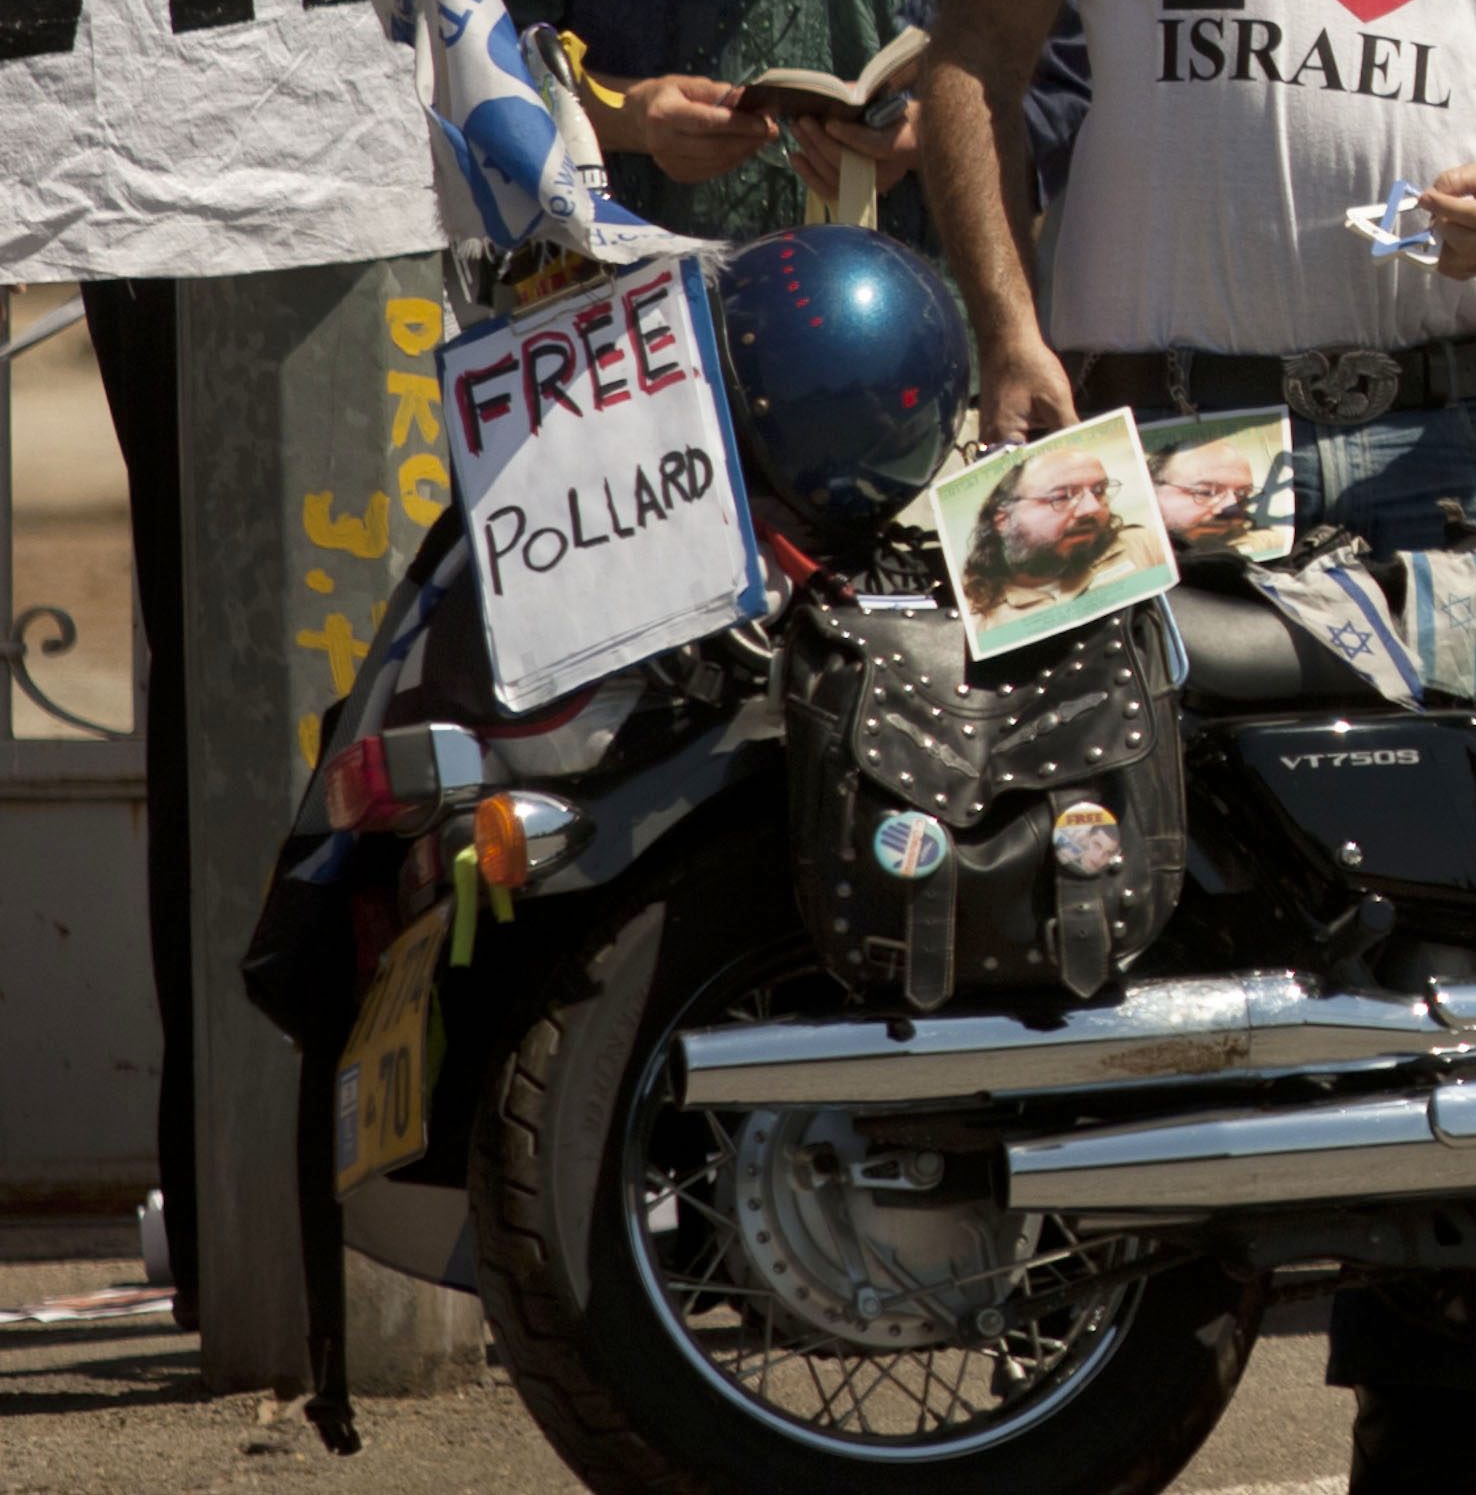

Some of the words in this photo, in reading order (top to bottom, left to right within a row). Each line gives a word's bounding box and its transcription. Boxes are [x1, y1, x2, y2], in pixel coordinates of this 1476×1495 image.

[1157, 18, 1450, 108] ISRAEL
[456, 271, 690, 456] FREE
[485, 445, 713, 596] POLLARD
[1281, 749, 1420, 770] VT750S
